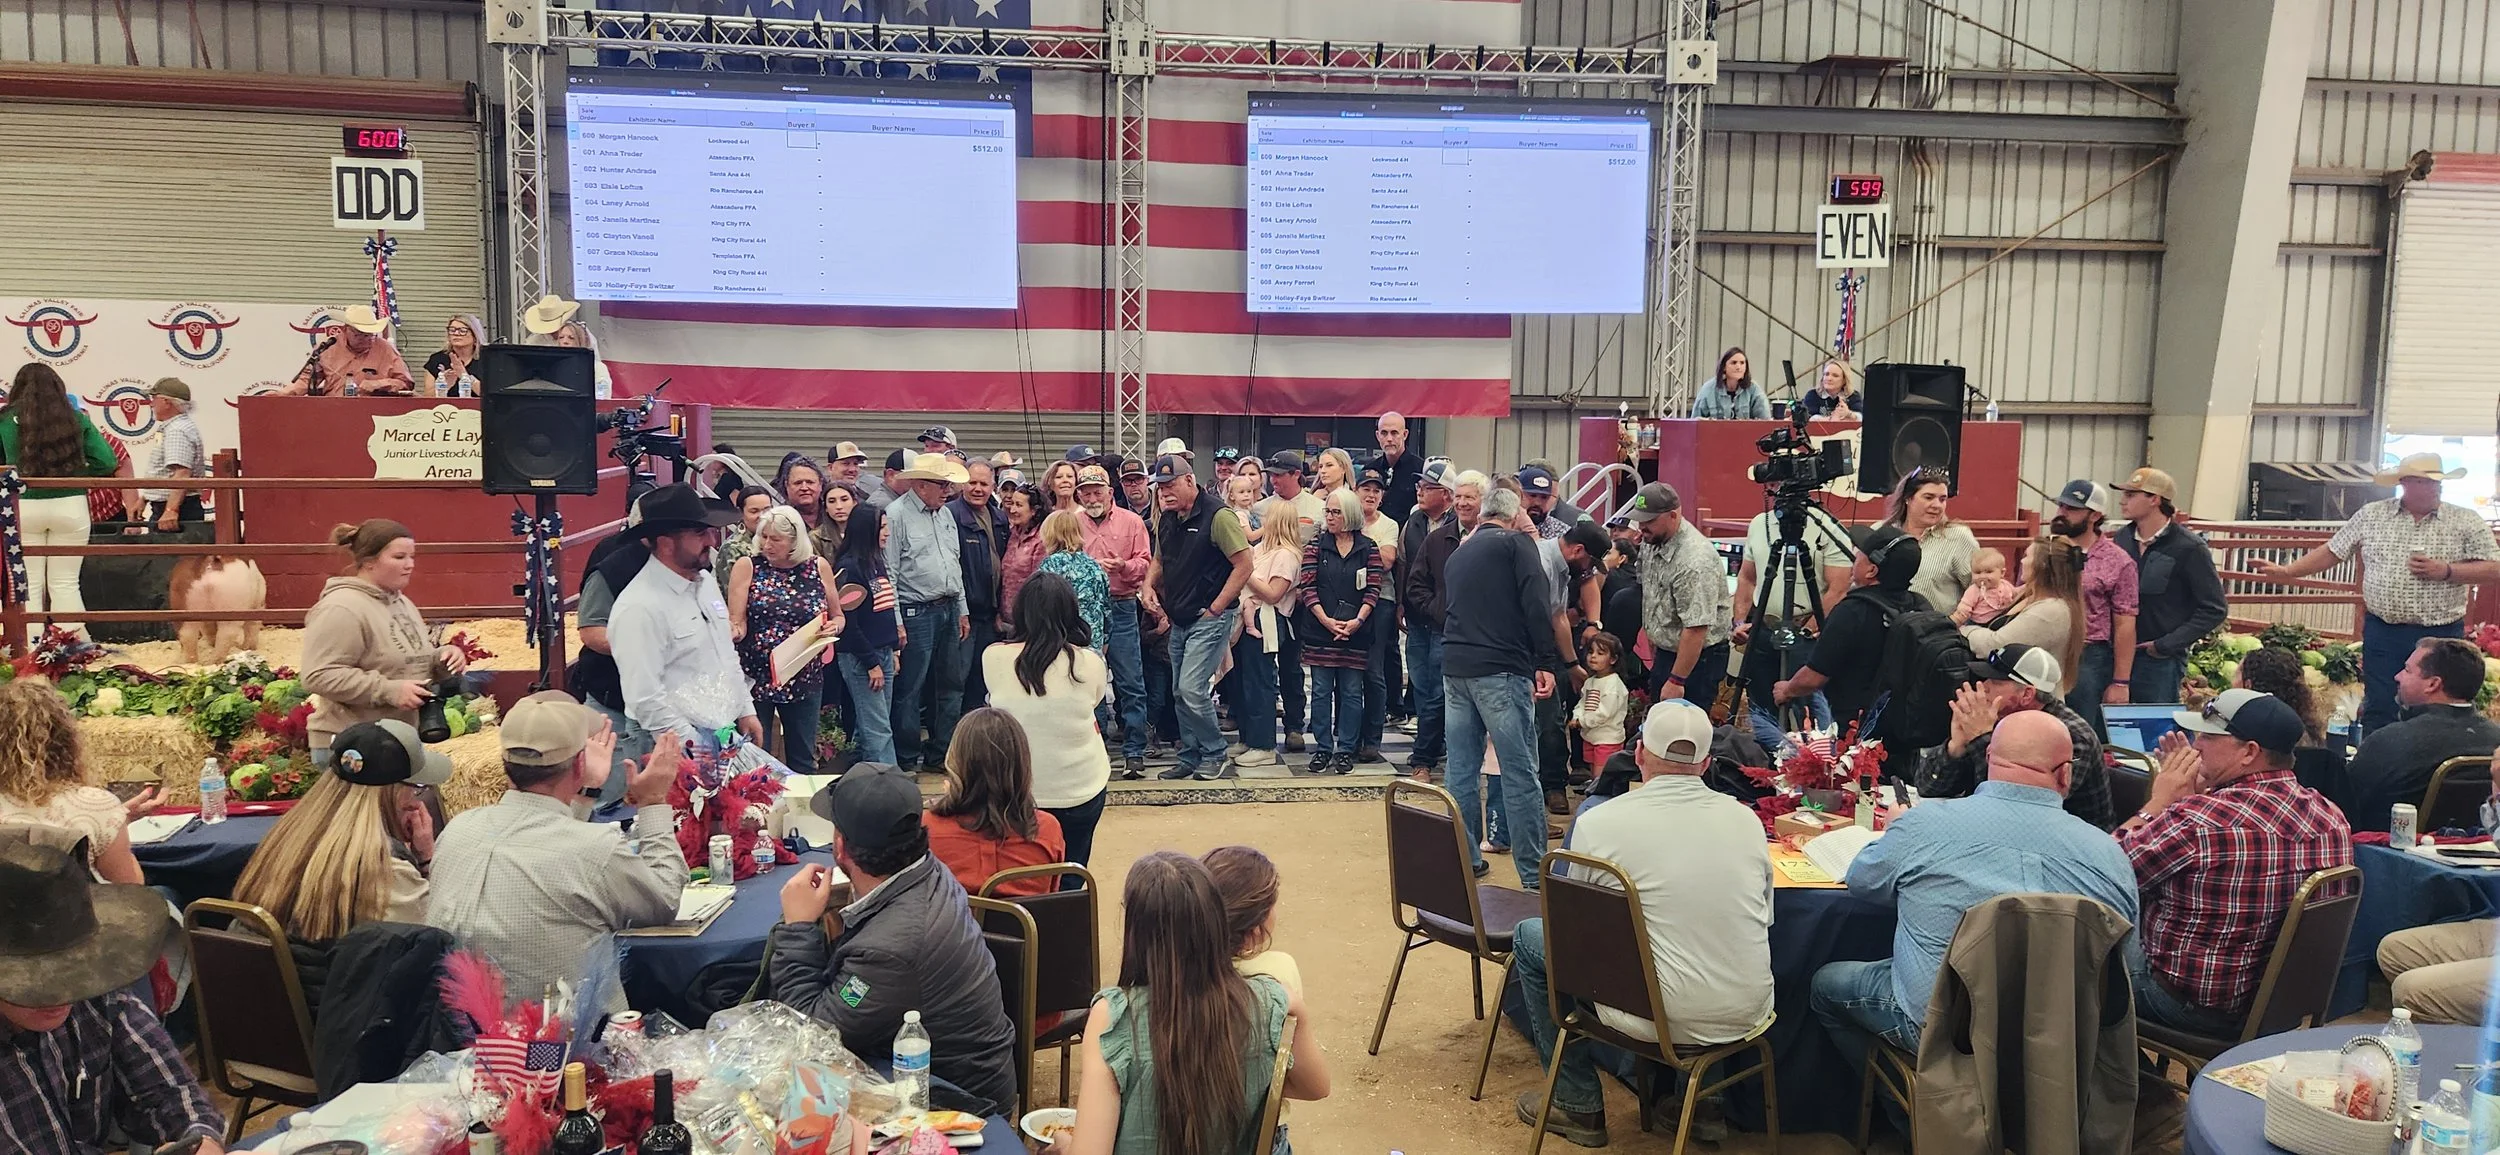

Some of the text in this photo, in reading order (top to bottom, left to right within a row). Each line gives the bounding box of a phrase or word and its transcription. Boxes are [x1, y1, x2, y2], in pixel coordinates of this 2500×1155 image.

[787, 122, 809, 130] Buyer
[872, 125, 893, 133] Buyer
[358, 130, 398, 148] 600
[972, 145, 1003, 153] $512.00
[336, 166, 418, 221] ODD
[1850, 181, 1881, 196] 599
[1821, 212, 1886, 259] EVEN
[20, 298, 84, 319] SALINAS VALLEY FAIR
[162, 301, 226, 322] SALINAS VALLEY FAIR
[303, 306, 325, 326] SALINAS
[23, 346, 37, 360] KING
[55, 344, 88, 367] CALIFORNIA
[197, 347, 231, 370] CALIFORNIA
[96, 377, 146, 399] SALINAS VALLEY
[260, 380, 287, 389] VALLEY
[432, 411, 458, 424] SVF
[383, 428, 482, 445] Marcel E Lay
[384, 448, 482, 458] Junior Livestock Au
[424, 465, 472, 478] Arena
